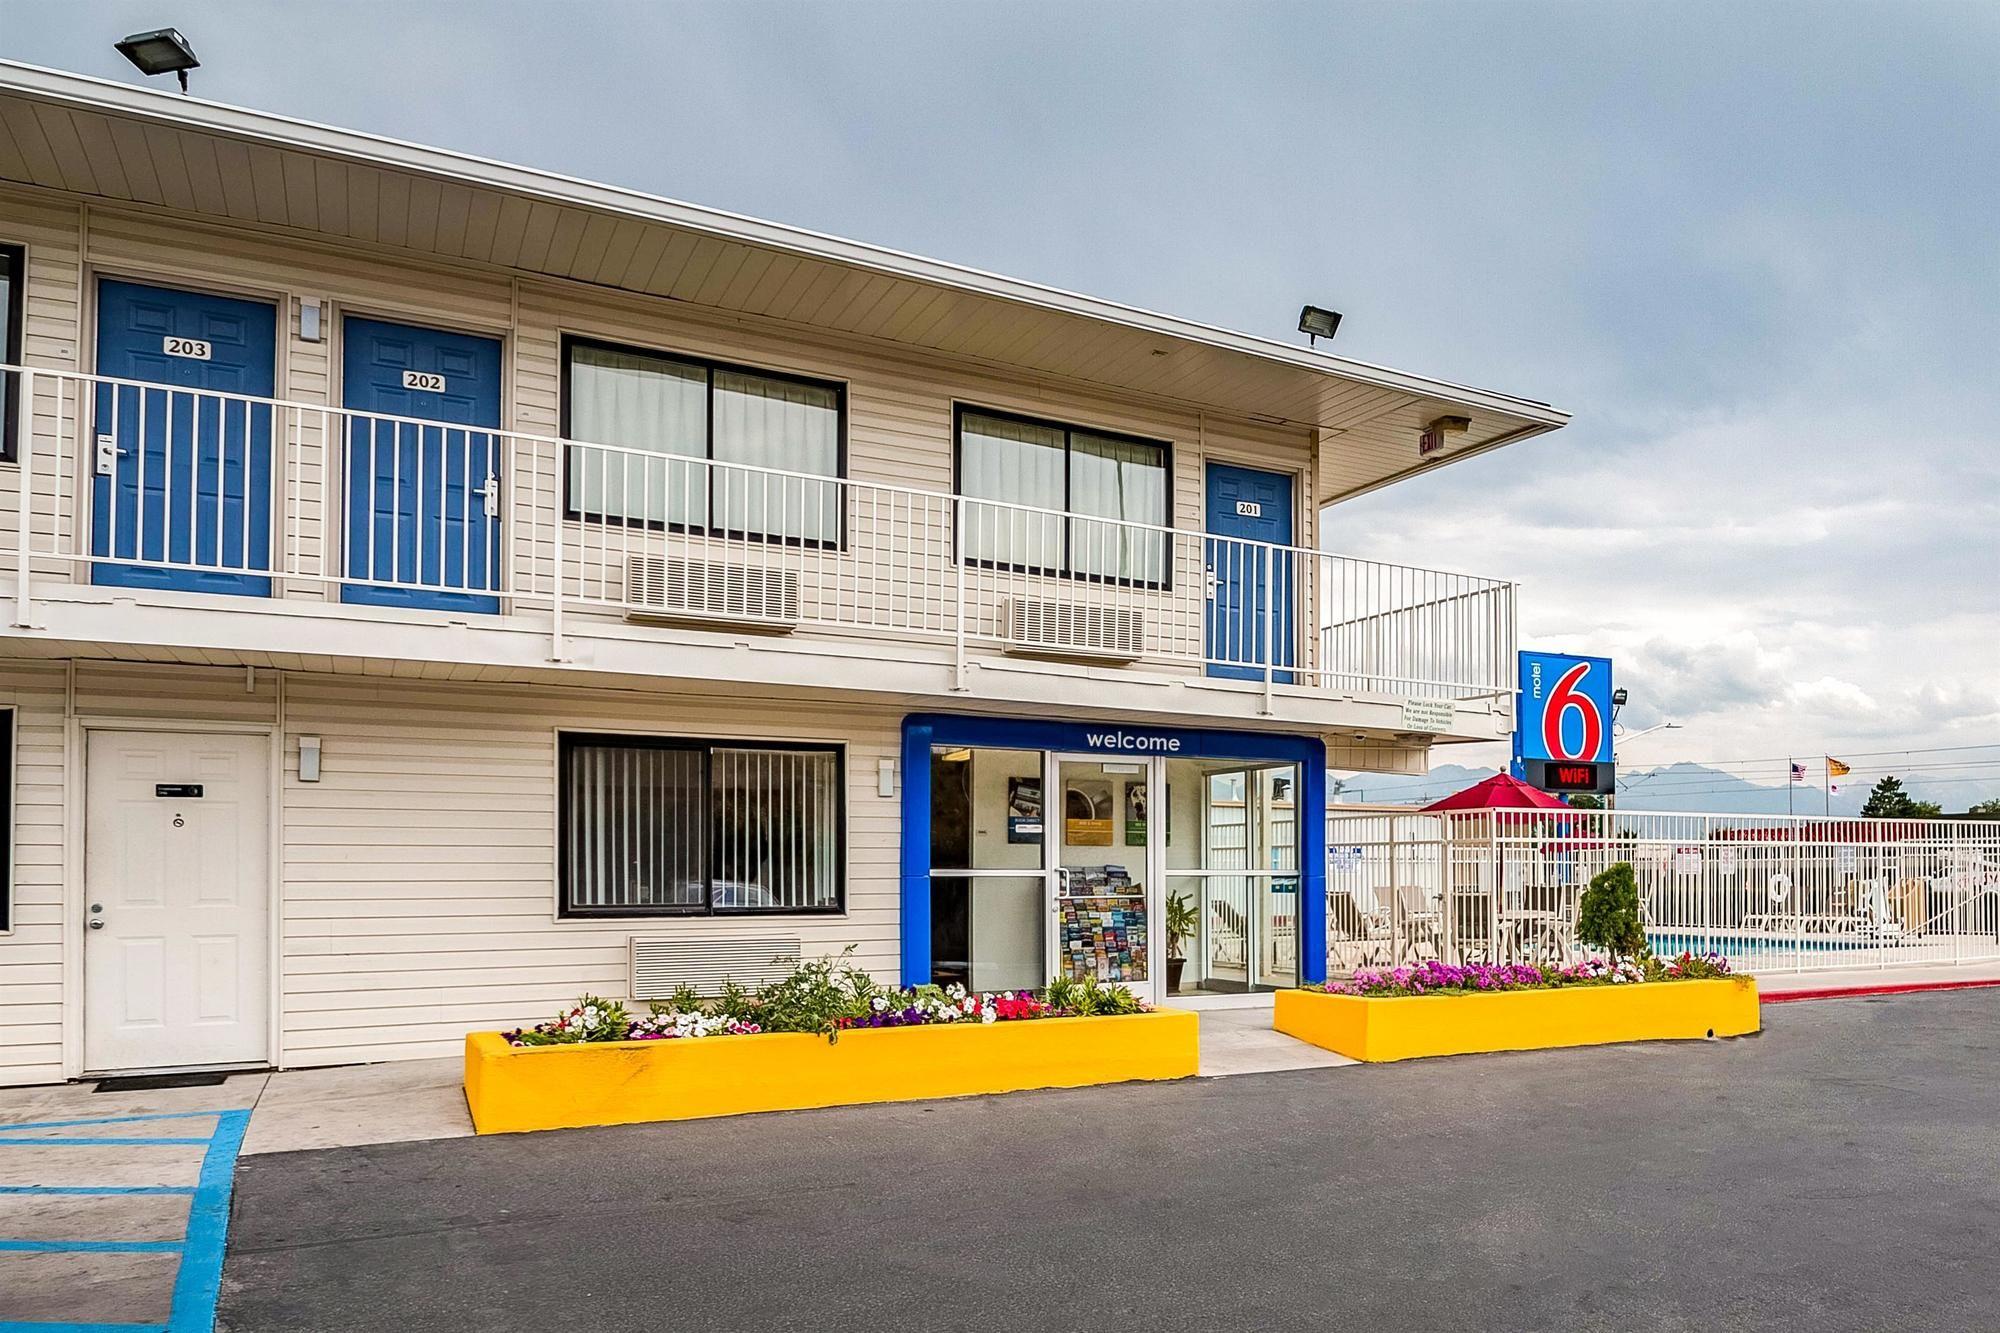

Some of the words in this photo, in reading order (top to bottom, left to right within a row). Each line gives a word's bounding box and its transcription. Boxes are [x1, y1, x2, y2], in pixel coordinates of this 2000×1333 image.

[169, 339, 206, 357] 203
[407, 373, 441, 390] 202
[1239, 503, 1258, 515] 201
[1531, 662, 1541, 699] motel
[1542, 661, 1602, 762] 6
[1087, 731, 1181, 751] welcome
[1559, 767, 1590, 785] WiFi
